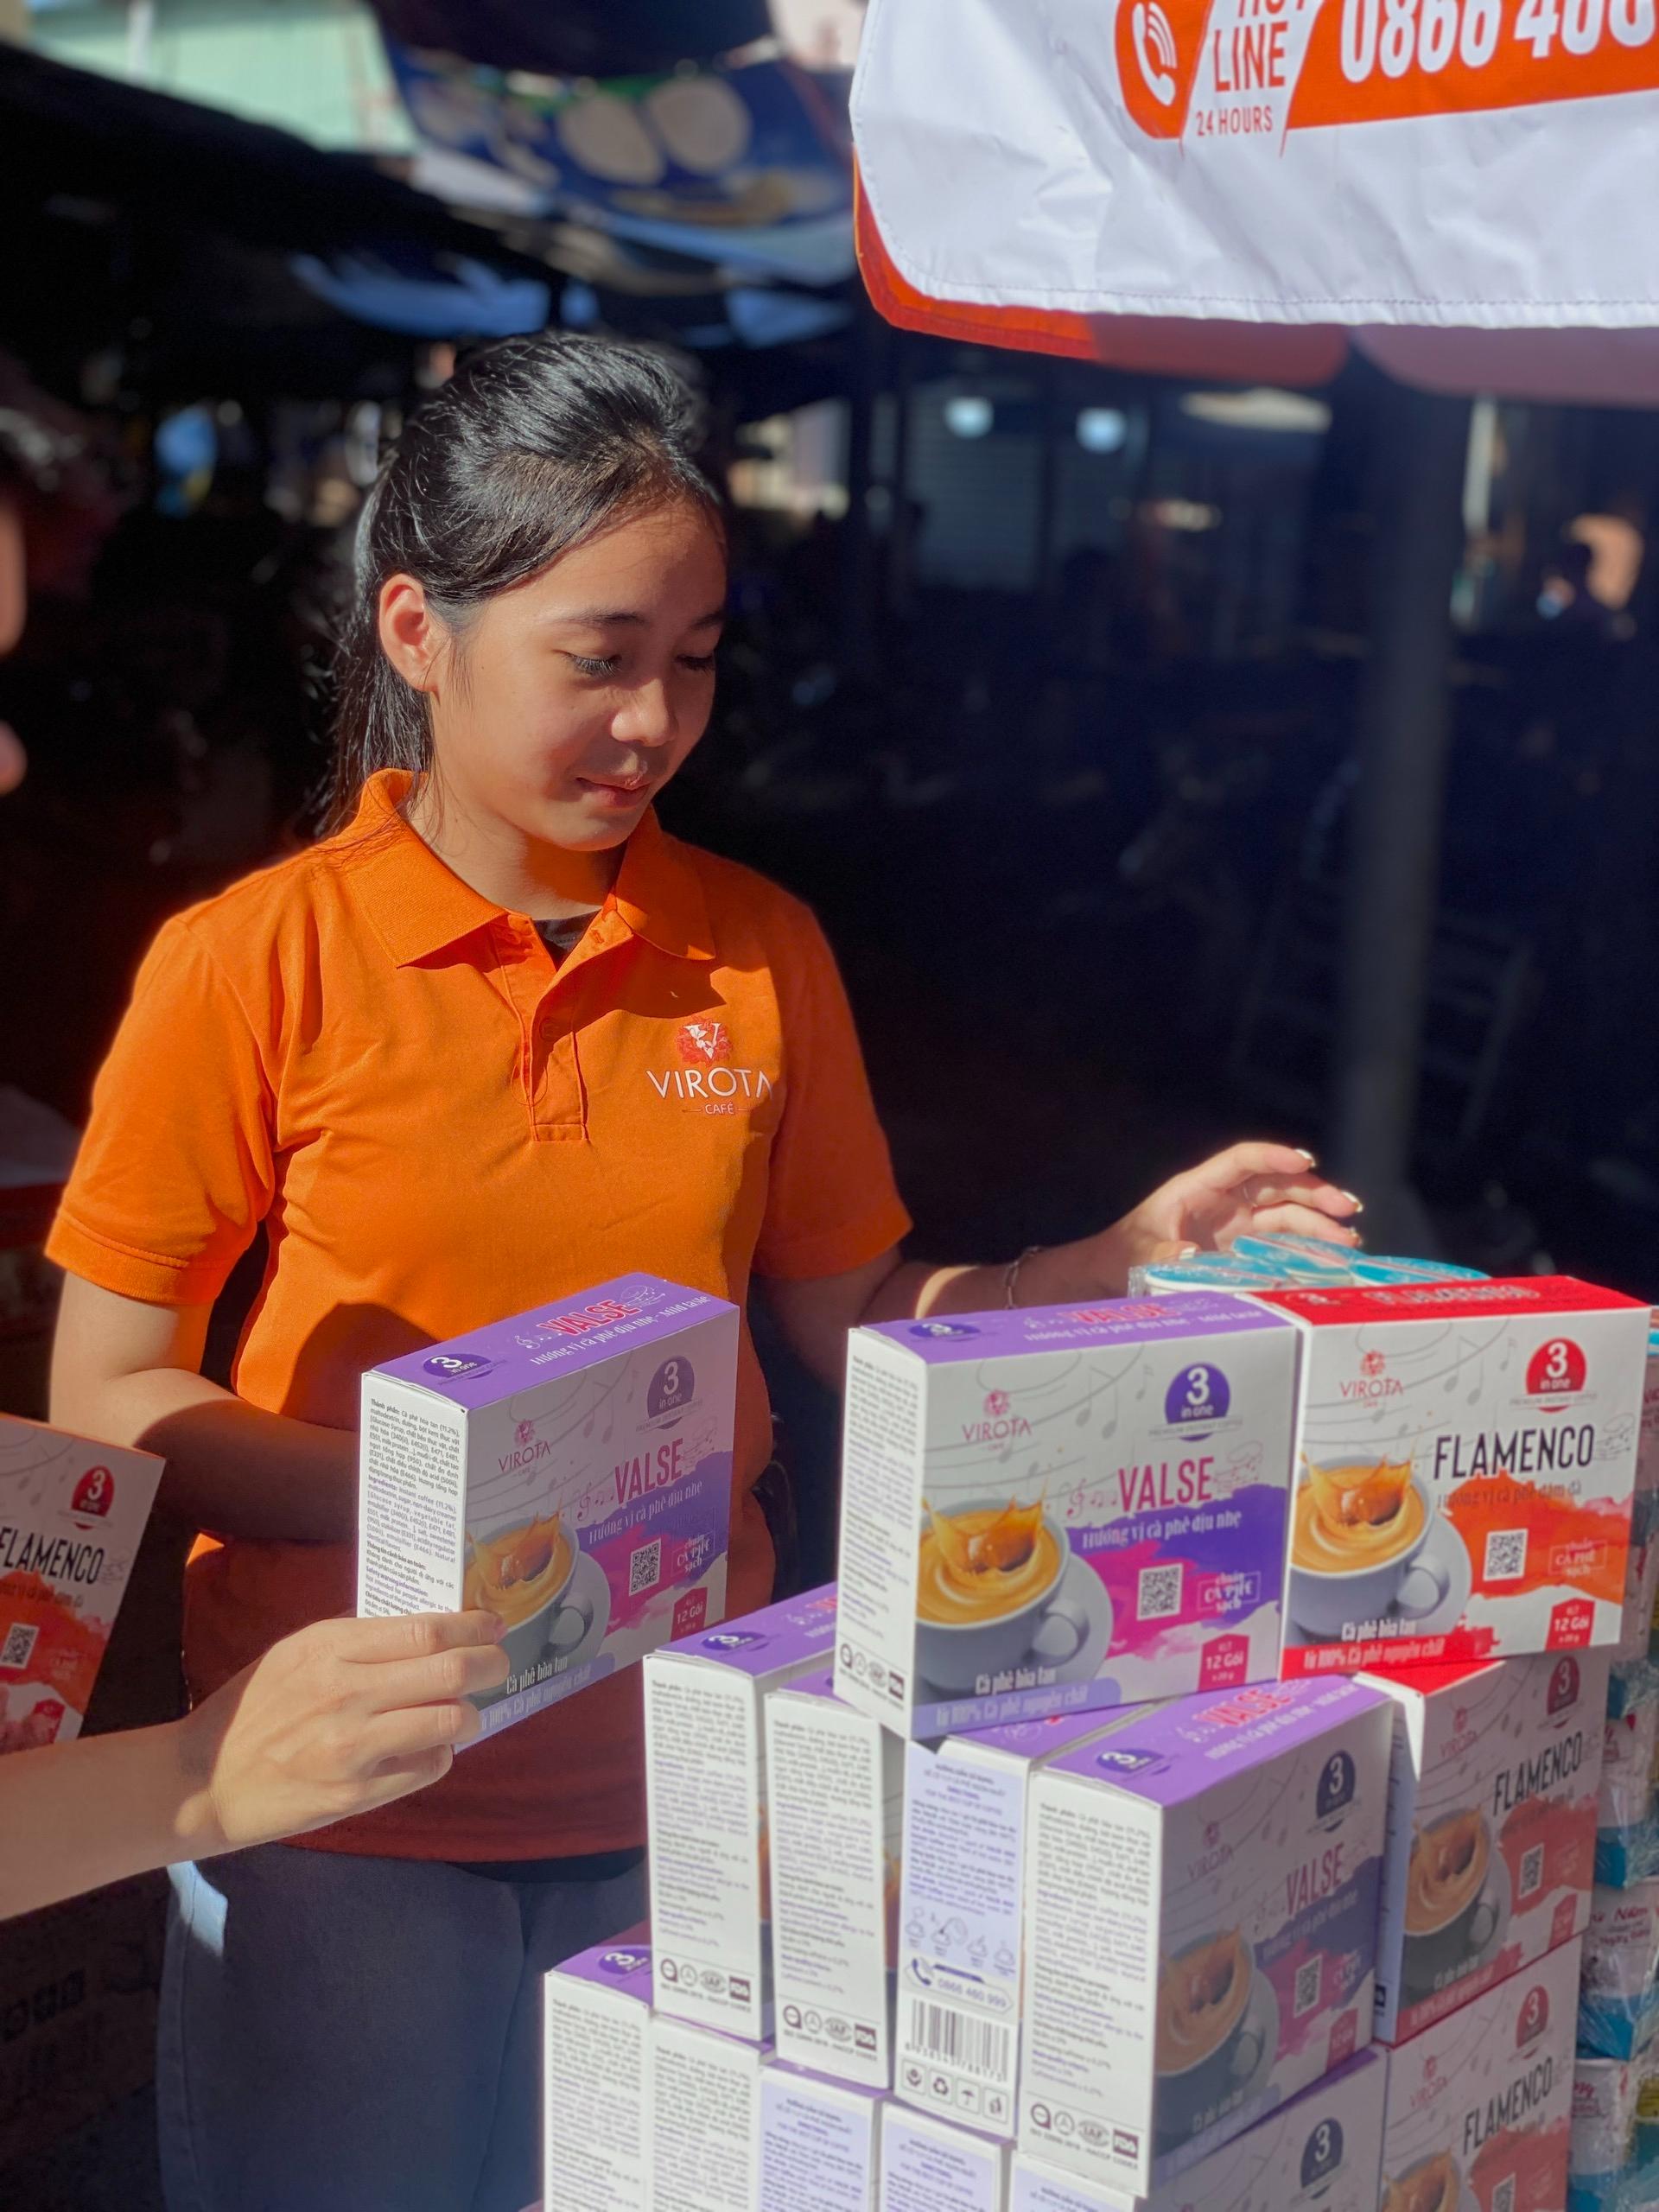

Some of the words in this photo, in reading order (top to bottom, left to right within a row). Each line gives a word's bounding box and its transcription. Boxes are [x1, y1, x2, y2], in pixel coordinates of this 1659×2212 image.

[1213, 21, 1288, 92] LINE
[1196, 110, 1213, 136] 24
[1218, 105, 1273, 135] HOURS
[646, 1067, 773, 1100] VIROTA
[705, 1102, 734, 1115] CAFÉ
[537, 1299, 643, 1336] VALSE
[431, 1357, 462, 1369] 3
[1546, 1341, 1568, 1378] 3
[663, 1362, 679, 1395] 3
[1186, 1367, 1210, 1406] 3
[1338, 1378, 1404, 1397] VIROTA
[658, 1397, 669, 1410] in
[669, 1392, 683, 1407] one
[962, 1417, 1033, 1441] VIROTA
[499, 1440, 551, 1472] VIROTA
[1433, 1424, 1594, 1479] FLAMENCO
[87, 1469, 105, 1501] 3
[614, 1438, 683, 1505] VALSE
[1118, 1457, 1214, 1512] VALSE
[0, 1526, 105, 1585] FLAMENCO
[677, 1609, 689, 1624] 12
[1554, 1617, 1570, 1632] 12
[506, 1673, 518, 1694] Cà
[519, 1664, 536, 1693] phê
[537, 1658, 553, 1681] hòa
[1205, 1654, 1222, 1670] 12
[1558, 1661, 1571, 1696] 3
[1328, 1757, 1344, 1795] 3
[1493, 1731, 1583, 1816] FLAMENCO
[1287, 1842, 1344, 1916] VALSE
[1527, 1990, 1540, 2025] 3
[1463, 2056, 1552, 2155] FLAMENCO
[1314, 2123, 1332, 2161] 3
